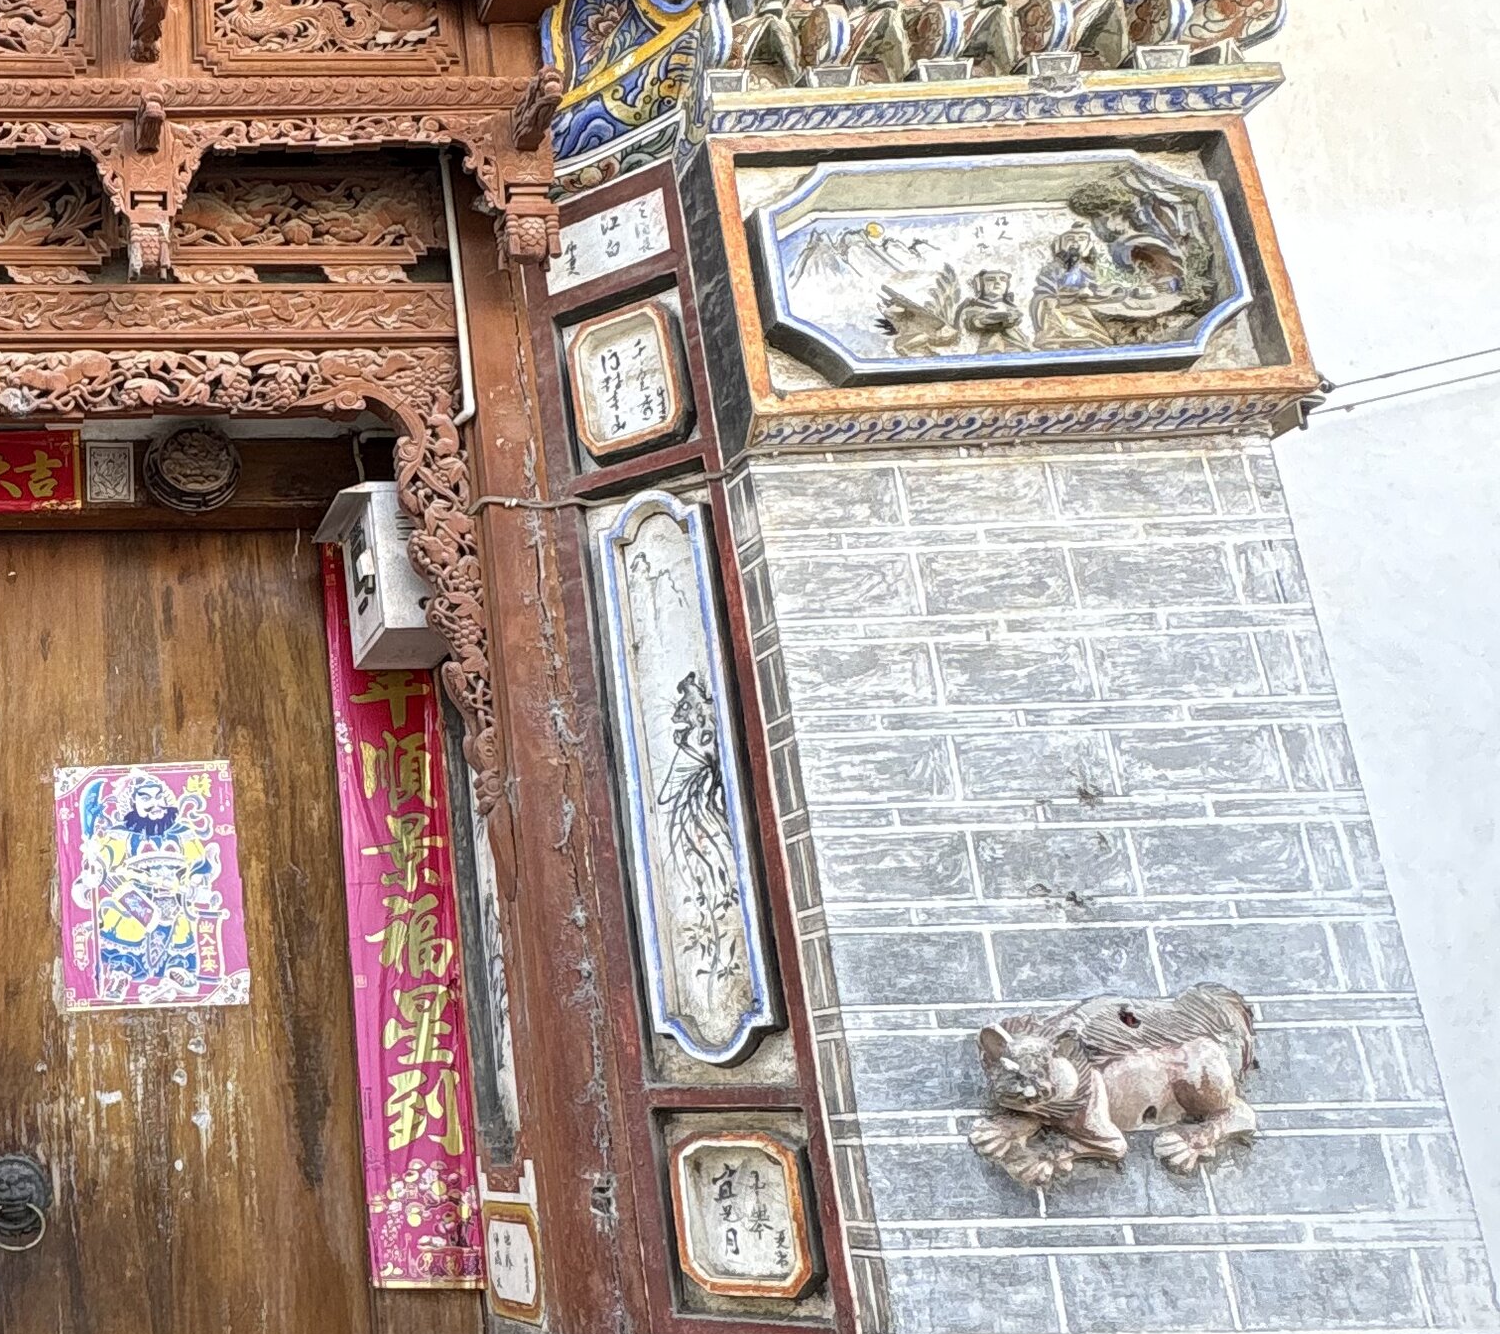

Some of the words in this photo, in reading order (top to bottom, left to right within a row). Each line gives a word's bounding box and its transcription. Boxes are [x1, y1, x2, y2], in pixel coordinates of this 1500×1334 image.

[198, 920, 219, 974] 出入平安
[348, 670, 465, 1156] 年順景福星到
